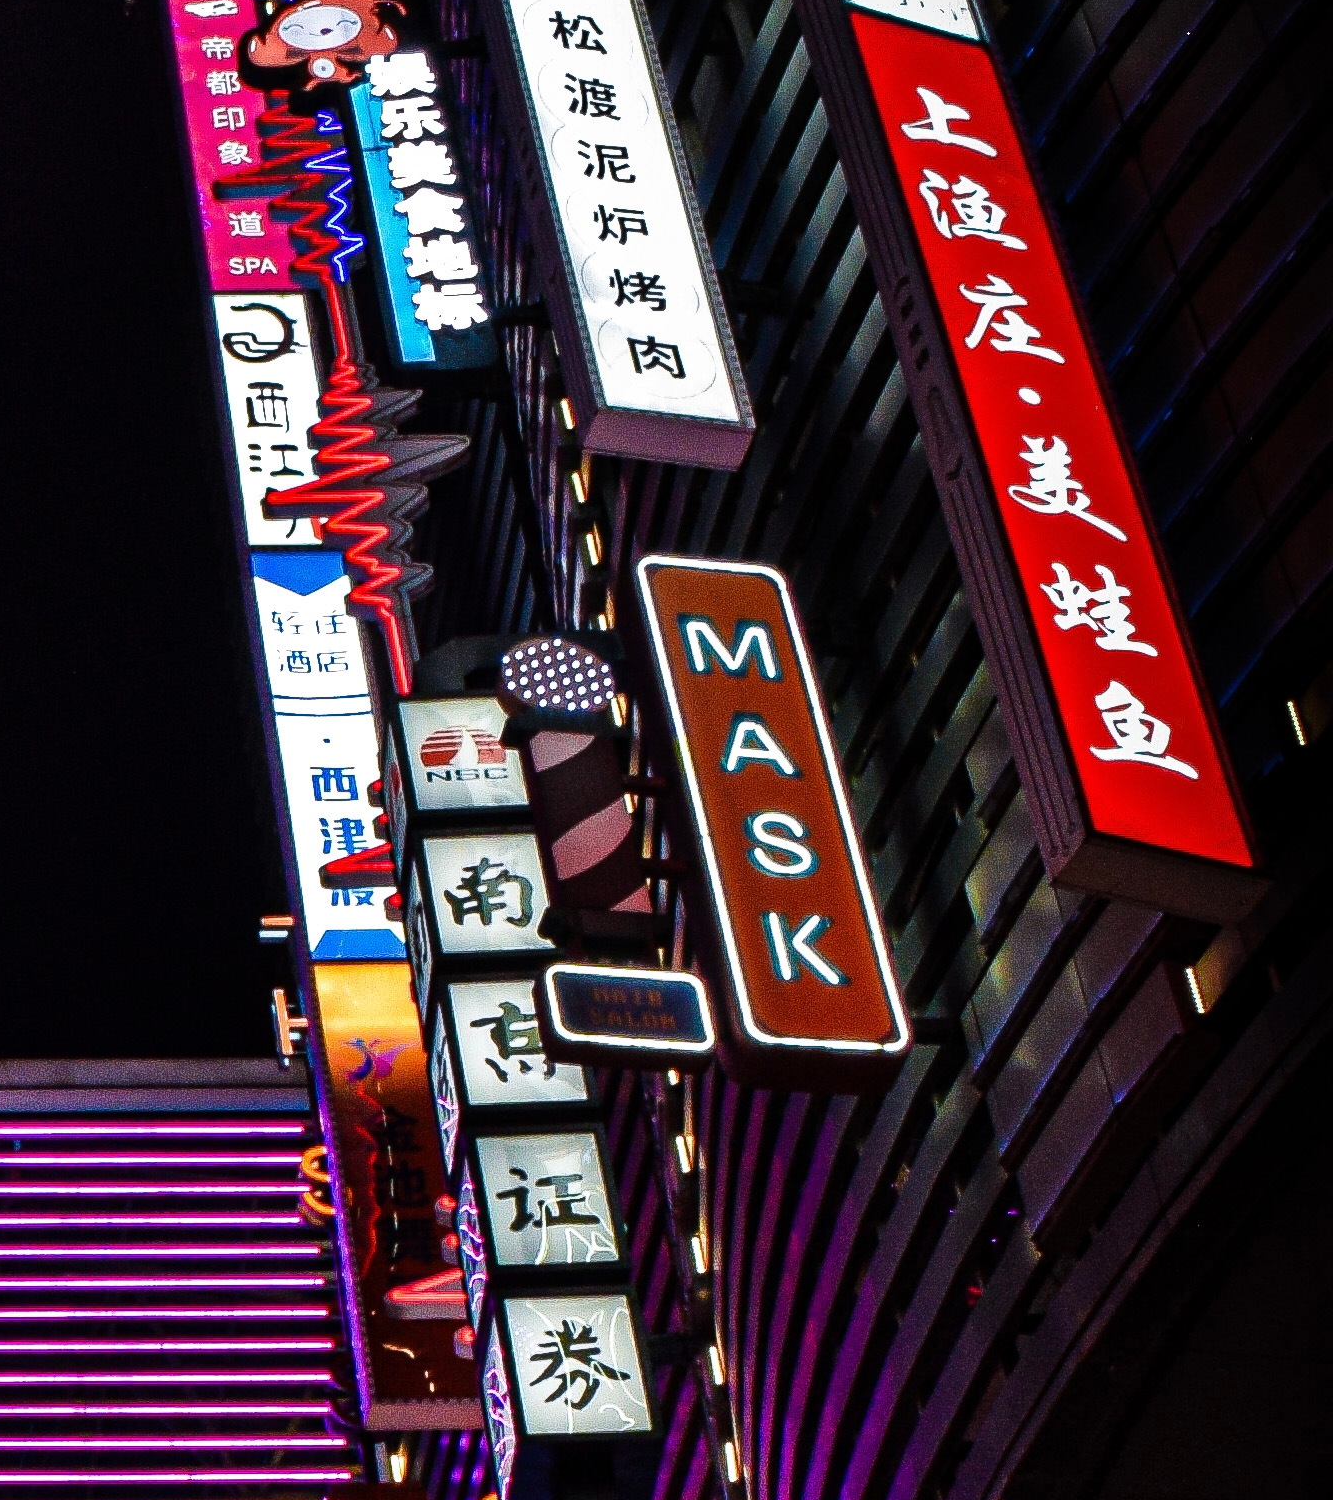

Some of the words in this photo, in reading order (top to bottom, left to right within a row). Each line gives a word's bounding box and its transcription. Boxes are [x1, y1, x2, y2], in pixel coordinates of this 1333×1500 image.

[200, 36, 255, 168] 帝都印象
[363, 51, 486, 332] 娱乐美食地标
[548, 9, 691, 381] 松渡泥炉烤肉
[228, 255, 278, 276] SPA
[426, 767, 510, 784] NSC
[683, 619, 846, 988] MASK
